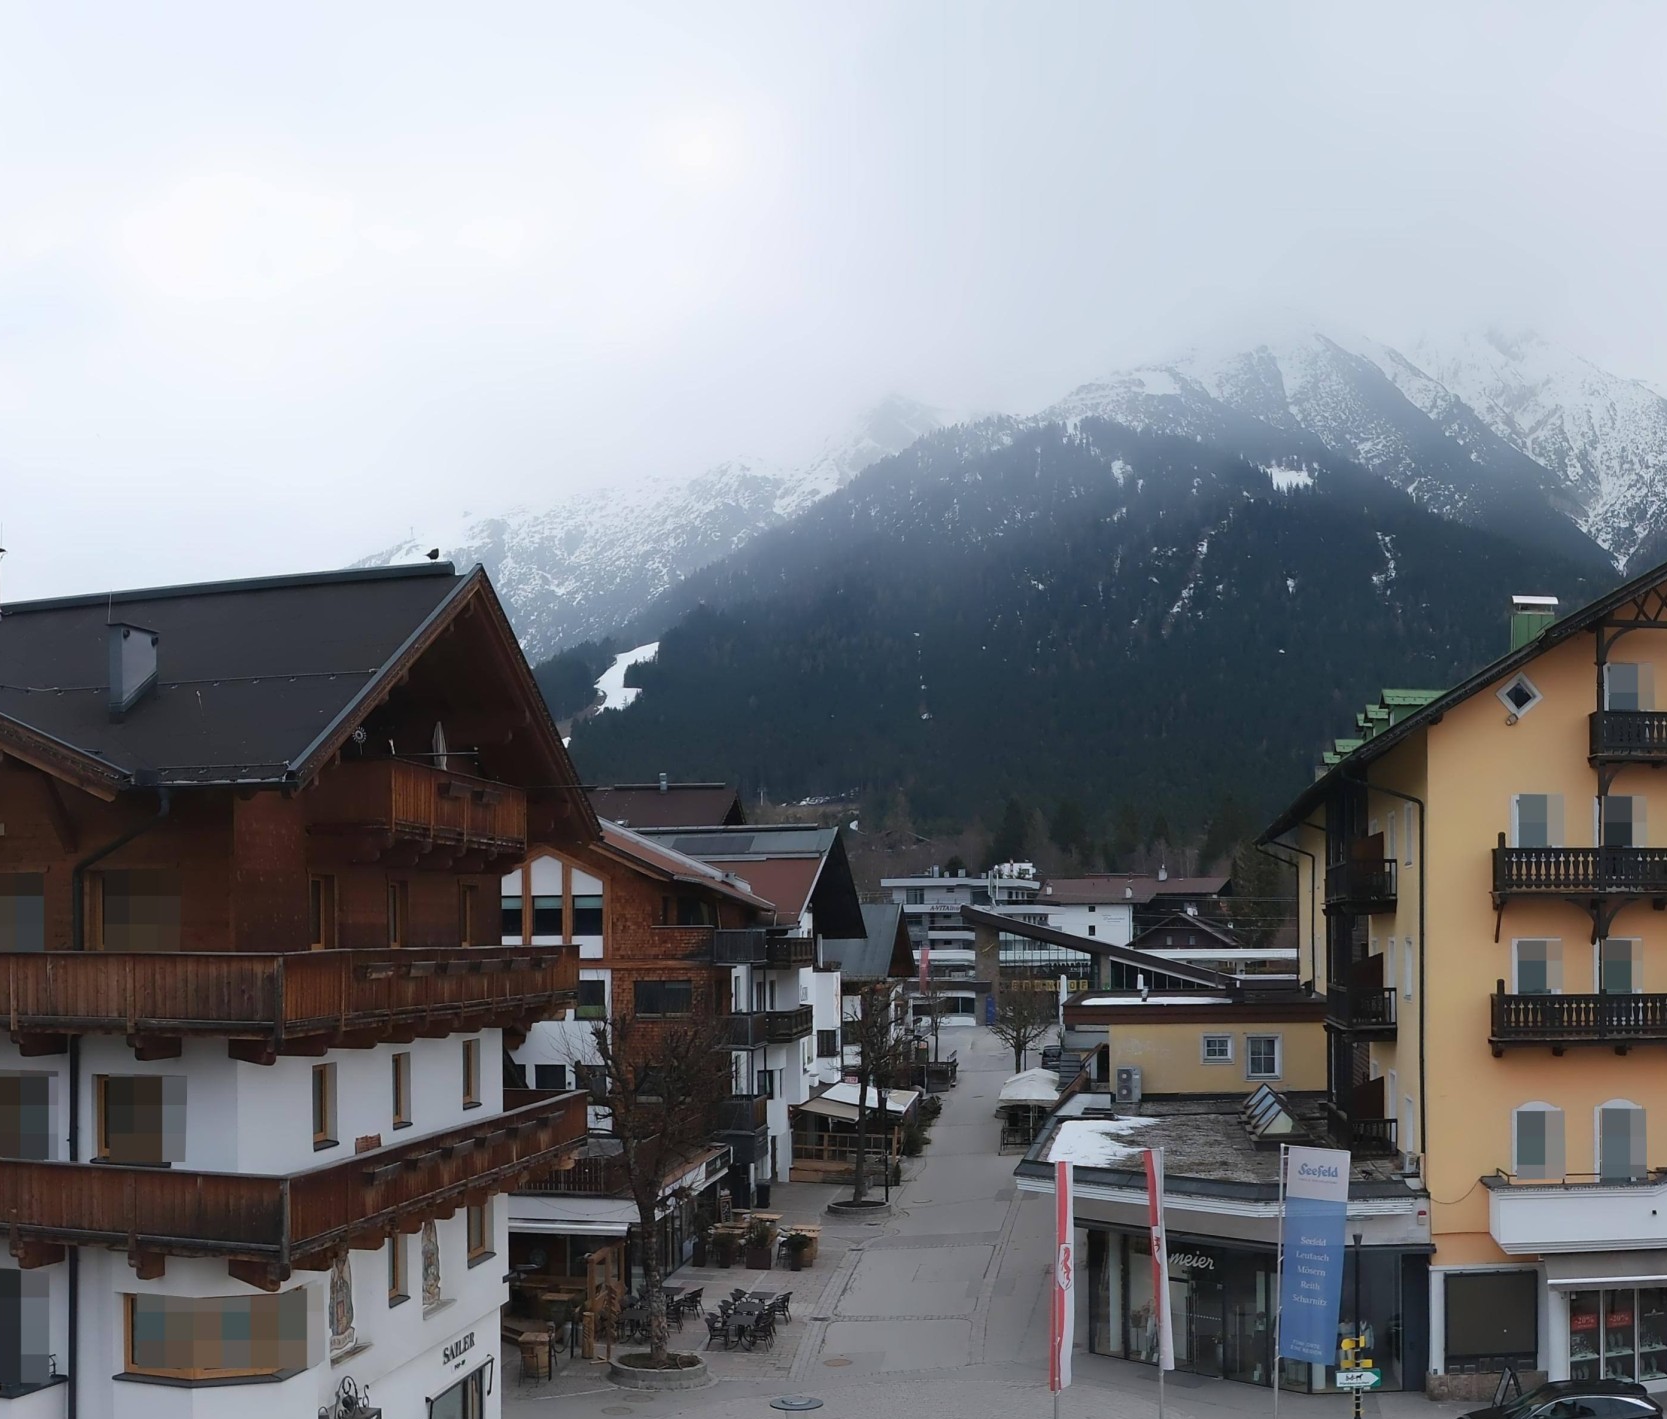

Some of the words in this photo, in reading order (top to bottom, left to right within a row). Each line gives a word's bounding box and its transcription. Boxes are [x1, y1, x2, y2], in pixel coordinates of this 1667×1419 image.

[1298, 1163, 1338, 1178] Seefeld
[1301, 1236, 1326, 1246] Seefeld
[1170, 1251, 1214, 1270] meier
[442, 1331, 475, 1365] SAILER
